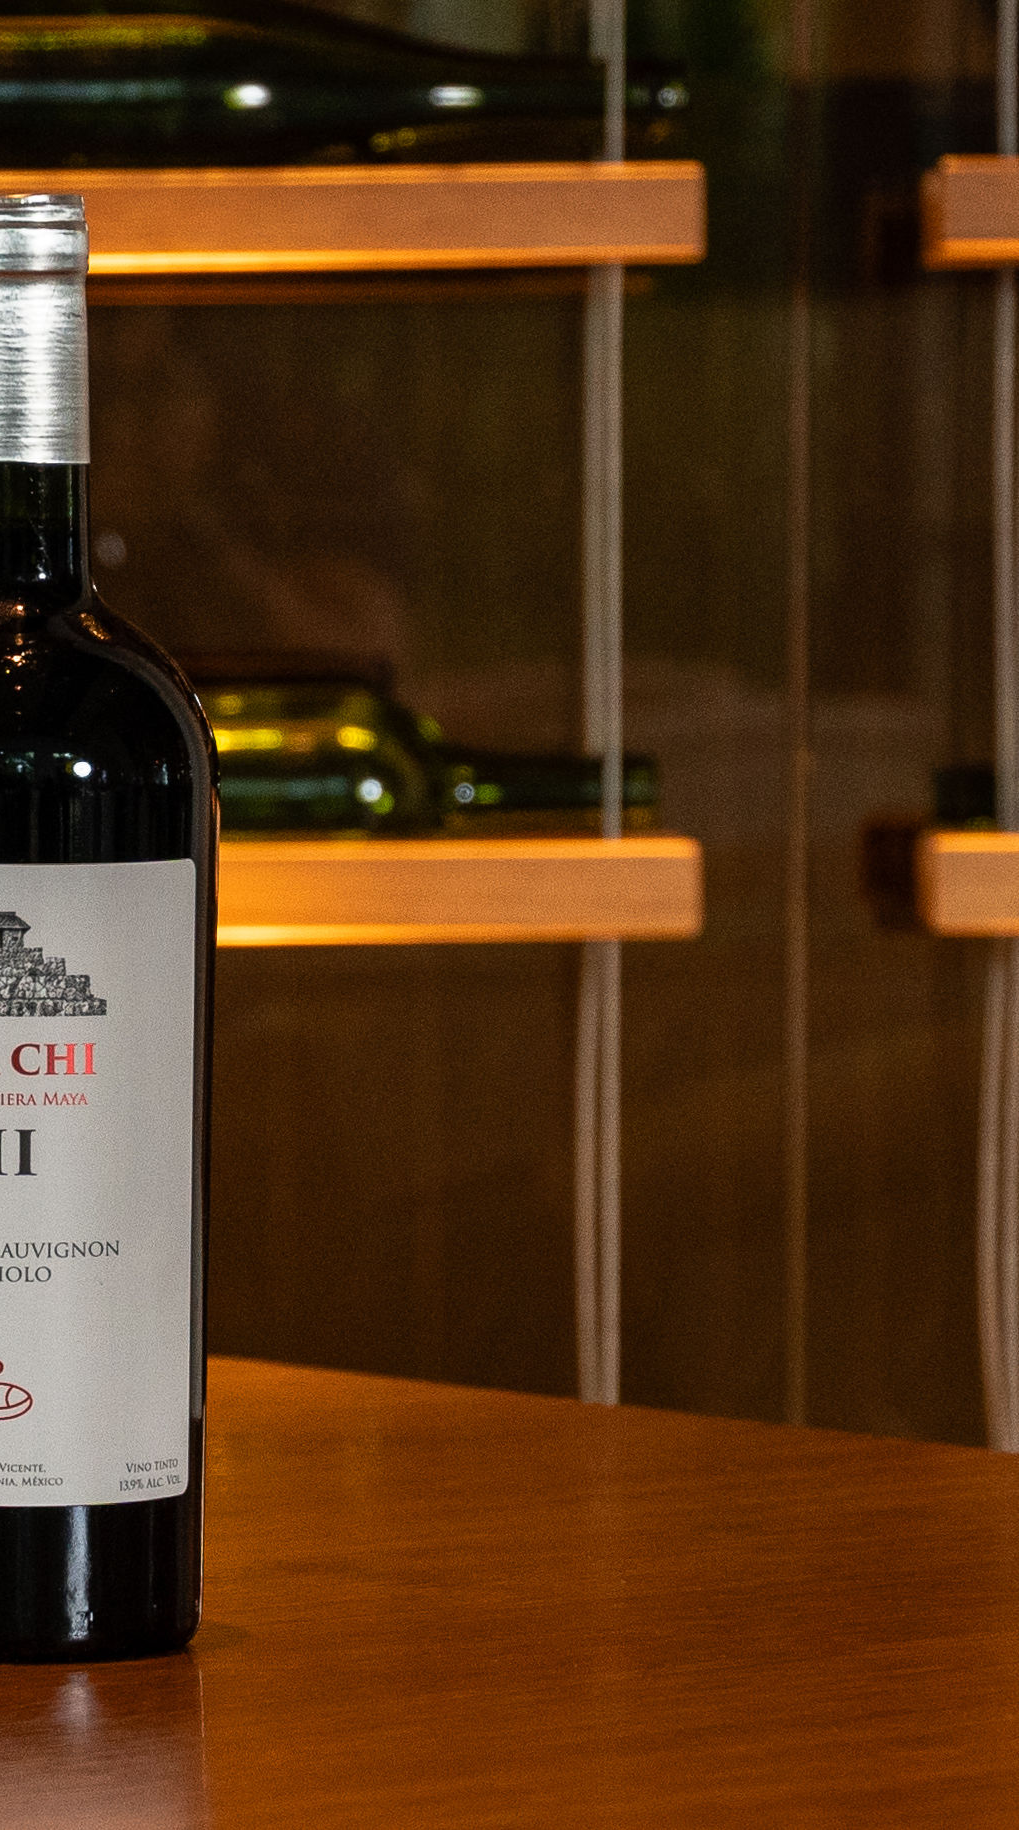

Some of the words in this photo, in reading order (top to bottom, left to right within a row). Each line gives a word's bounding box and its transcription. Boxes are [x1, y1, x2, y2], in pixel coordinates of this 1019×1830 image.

[11, 1043, 97, 1076] CHI
[43, 1092, 88, 1106] MAYA
[126, 1462, 151, 1474] VINO
[154, 1458, 178, 1471] TINTO
